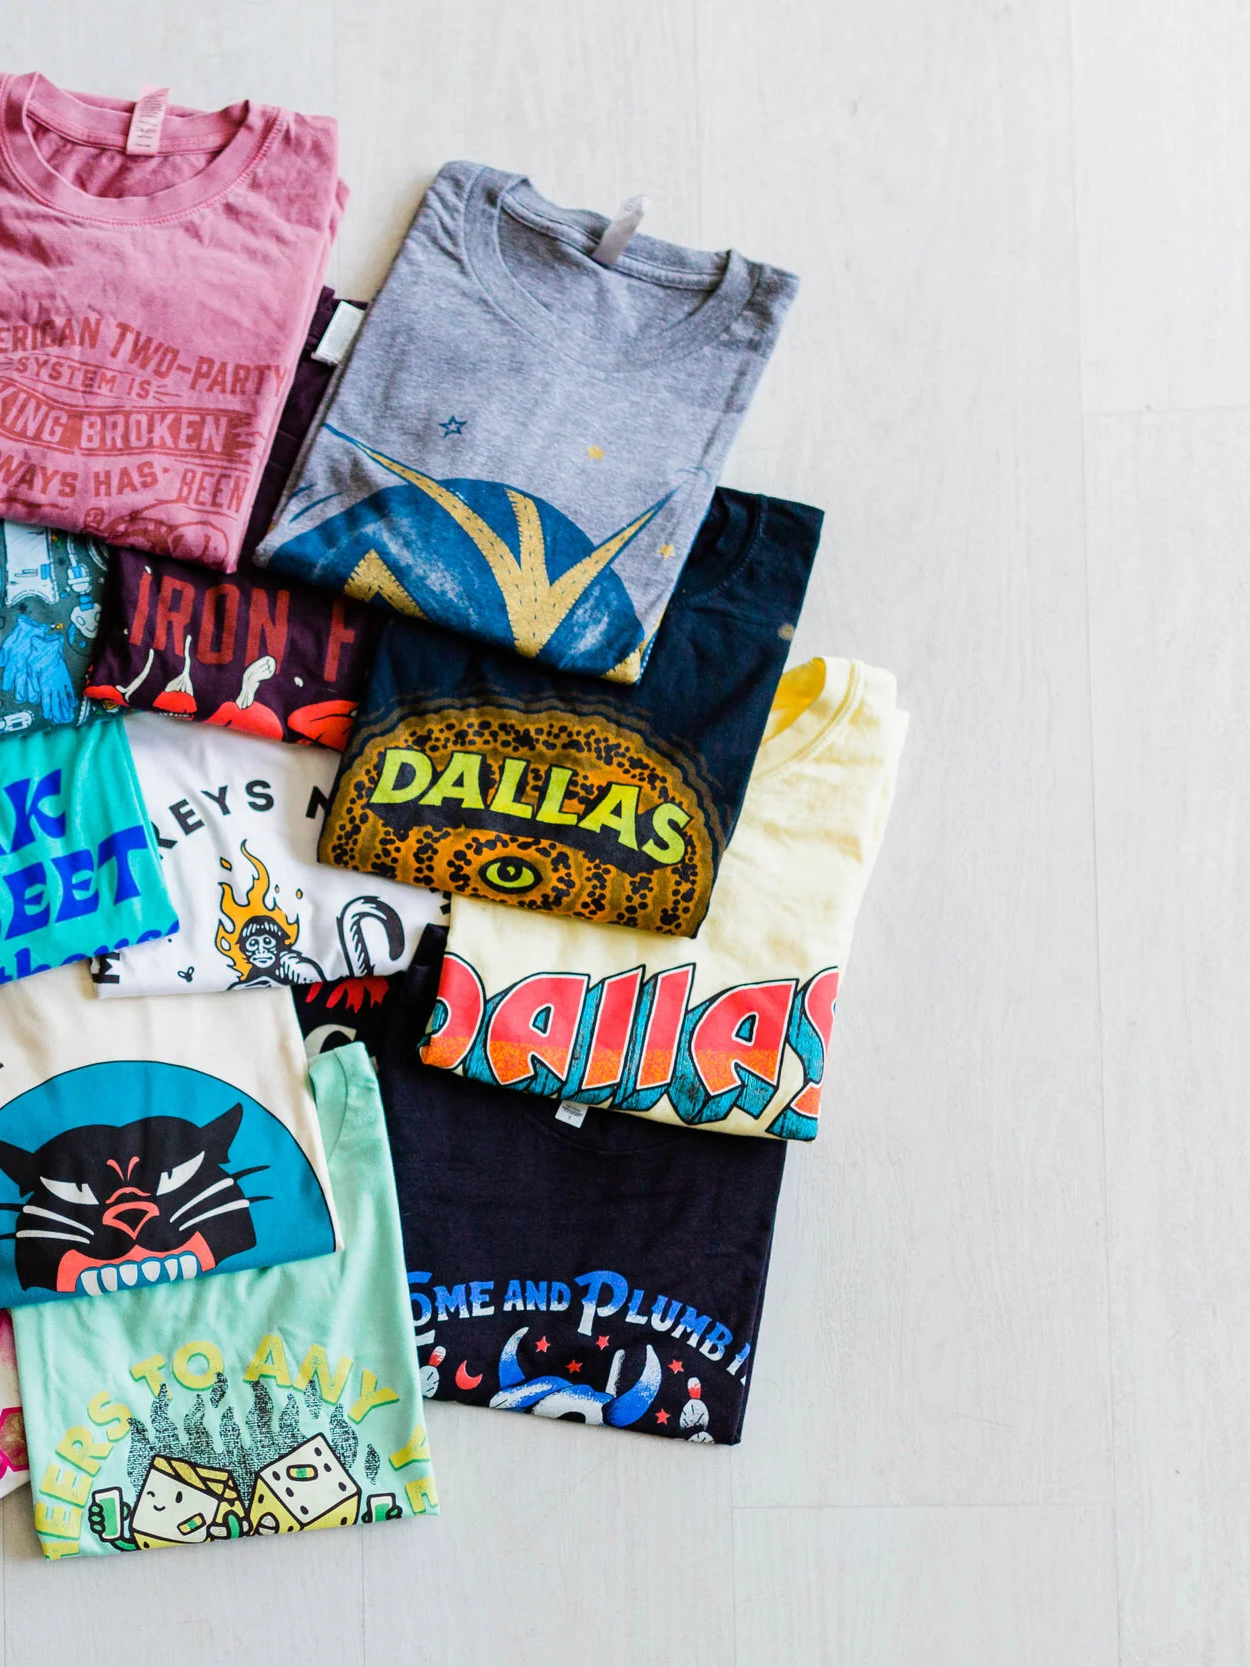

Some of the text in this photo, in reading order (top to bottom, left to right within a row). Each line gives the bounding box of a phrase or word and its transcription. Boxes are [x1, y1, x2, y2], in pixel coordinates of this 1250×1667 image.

[16, 355, 153, 399] SYSTEM IS
[109, 322, 288, 397] TWO-PARTY
[80, 413, 228, 452] BROKEN
[93, 461, 158, 498] HAS
[177, 467, 249, 513] BEEN
[128, 571, 290, 675] IRON
[369, 748, 690, 865] DALLAS
[503, 1280, 572, 1312] AND
[130, 1340, 224, 1400] TO
[243, 1335, 400, 1425] ANY
